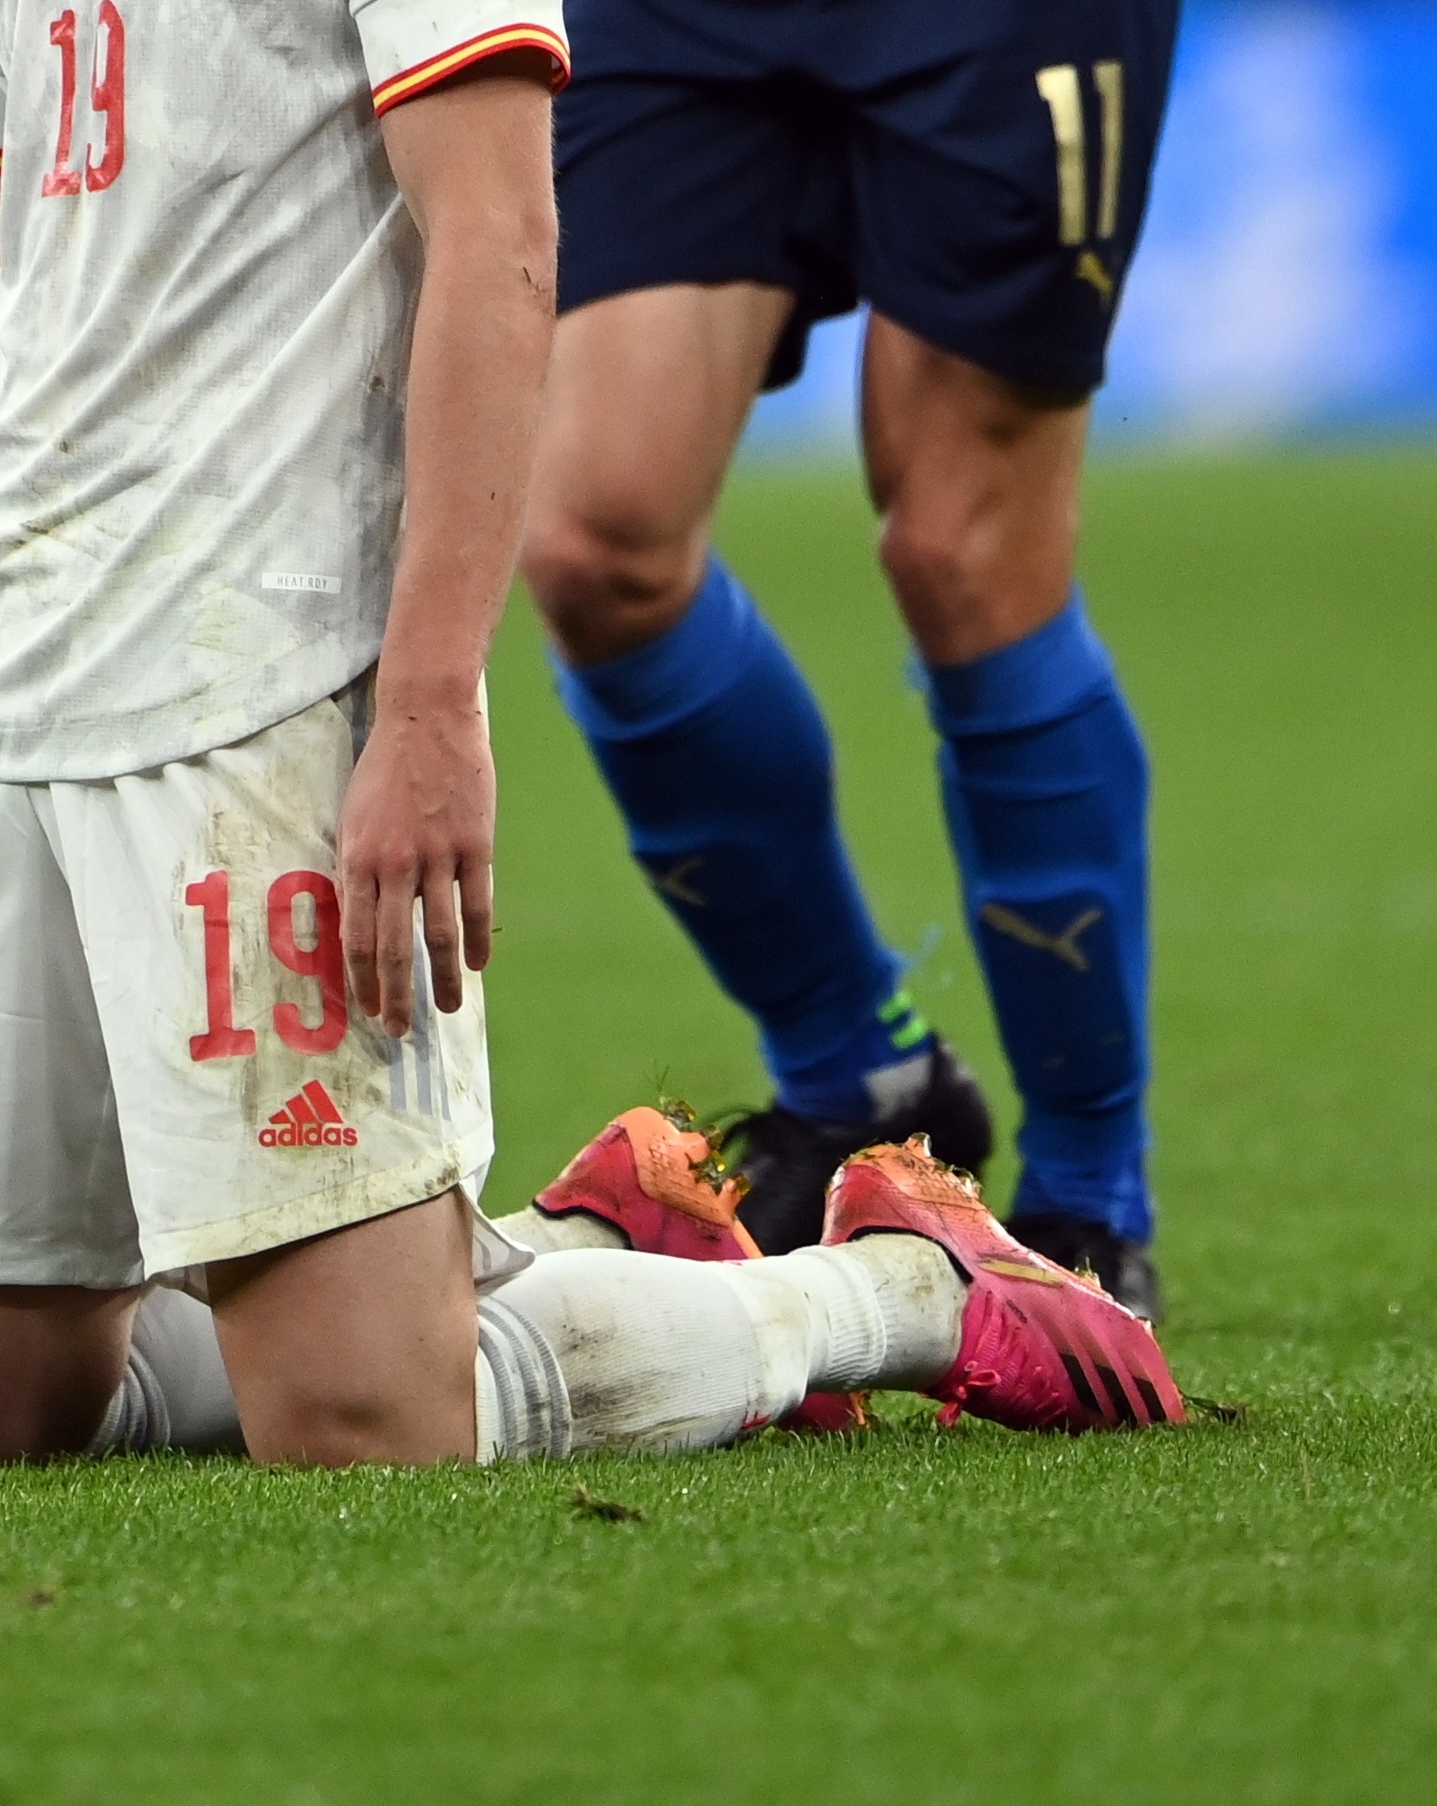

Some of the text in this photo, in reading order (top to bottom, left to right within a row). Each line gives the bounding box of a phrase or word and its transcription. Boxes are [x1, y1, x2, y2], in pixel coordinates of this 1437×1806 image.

[1034, 59, 1125, 246] 11
[185, 869, 348, 1062] 19
[258, 1120, 358, 1148] adidas
